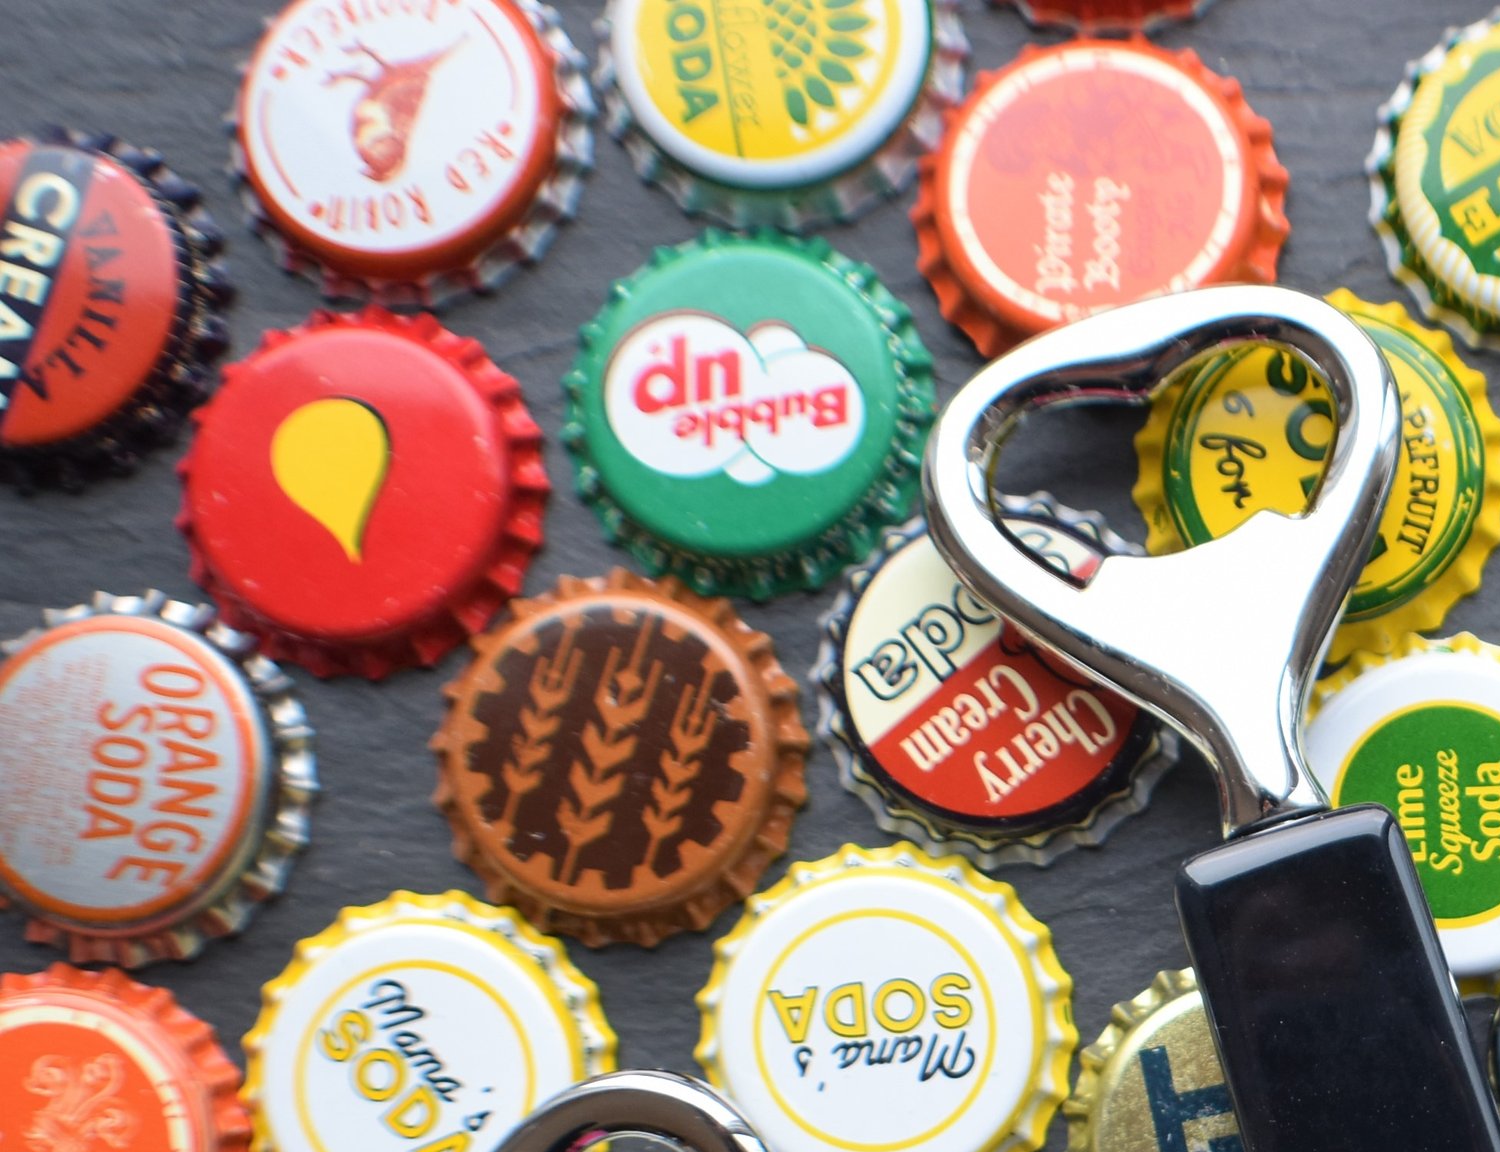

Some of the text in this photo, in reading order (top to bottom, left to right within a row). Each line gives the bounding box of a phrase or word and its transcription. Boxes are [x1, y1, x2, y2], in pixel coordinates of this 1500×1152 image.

[665, 0, 719, 123] ODA
[324, 128, 515, 232] RED ROBIN
[24, 208, 126, 400] VANILLA
[674, 384, 848, 448] Bubble
[1200, 432, 1267, 510] for
[80, 699, 157, 842] SODA
[899, 664, 1040, 772] Cream
[973, 690, 1117, 804] Cherry
[105, 662, 223, 891] ORANGE
[1429, 748, 1465, 876] Squeeze
[360, 976, 495, 1133] Mama's
[768, 973, 973, 1044] SODA
[794, 1030, 977, 1093] Mama's
